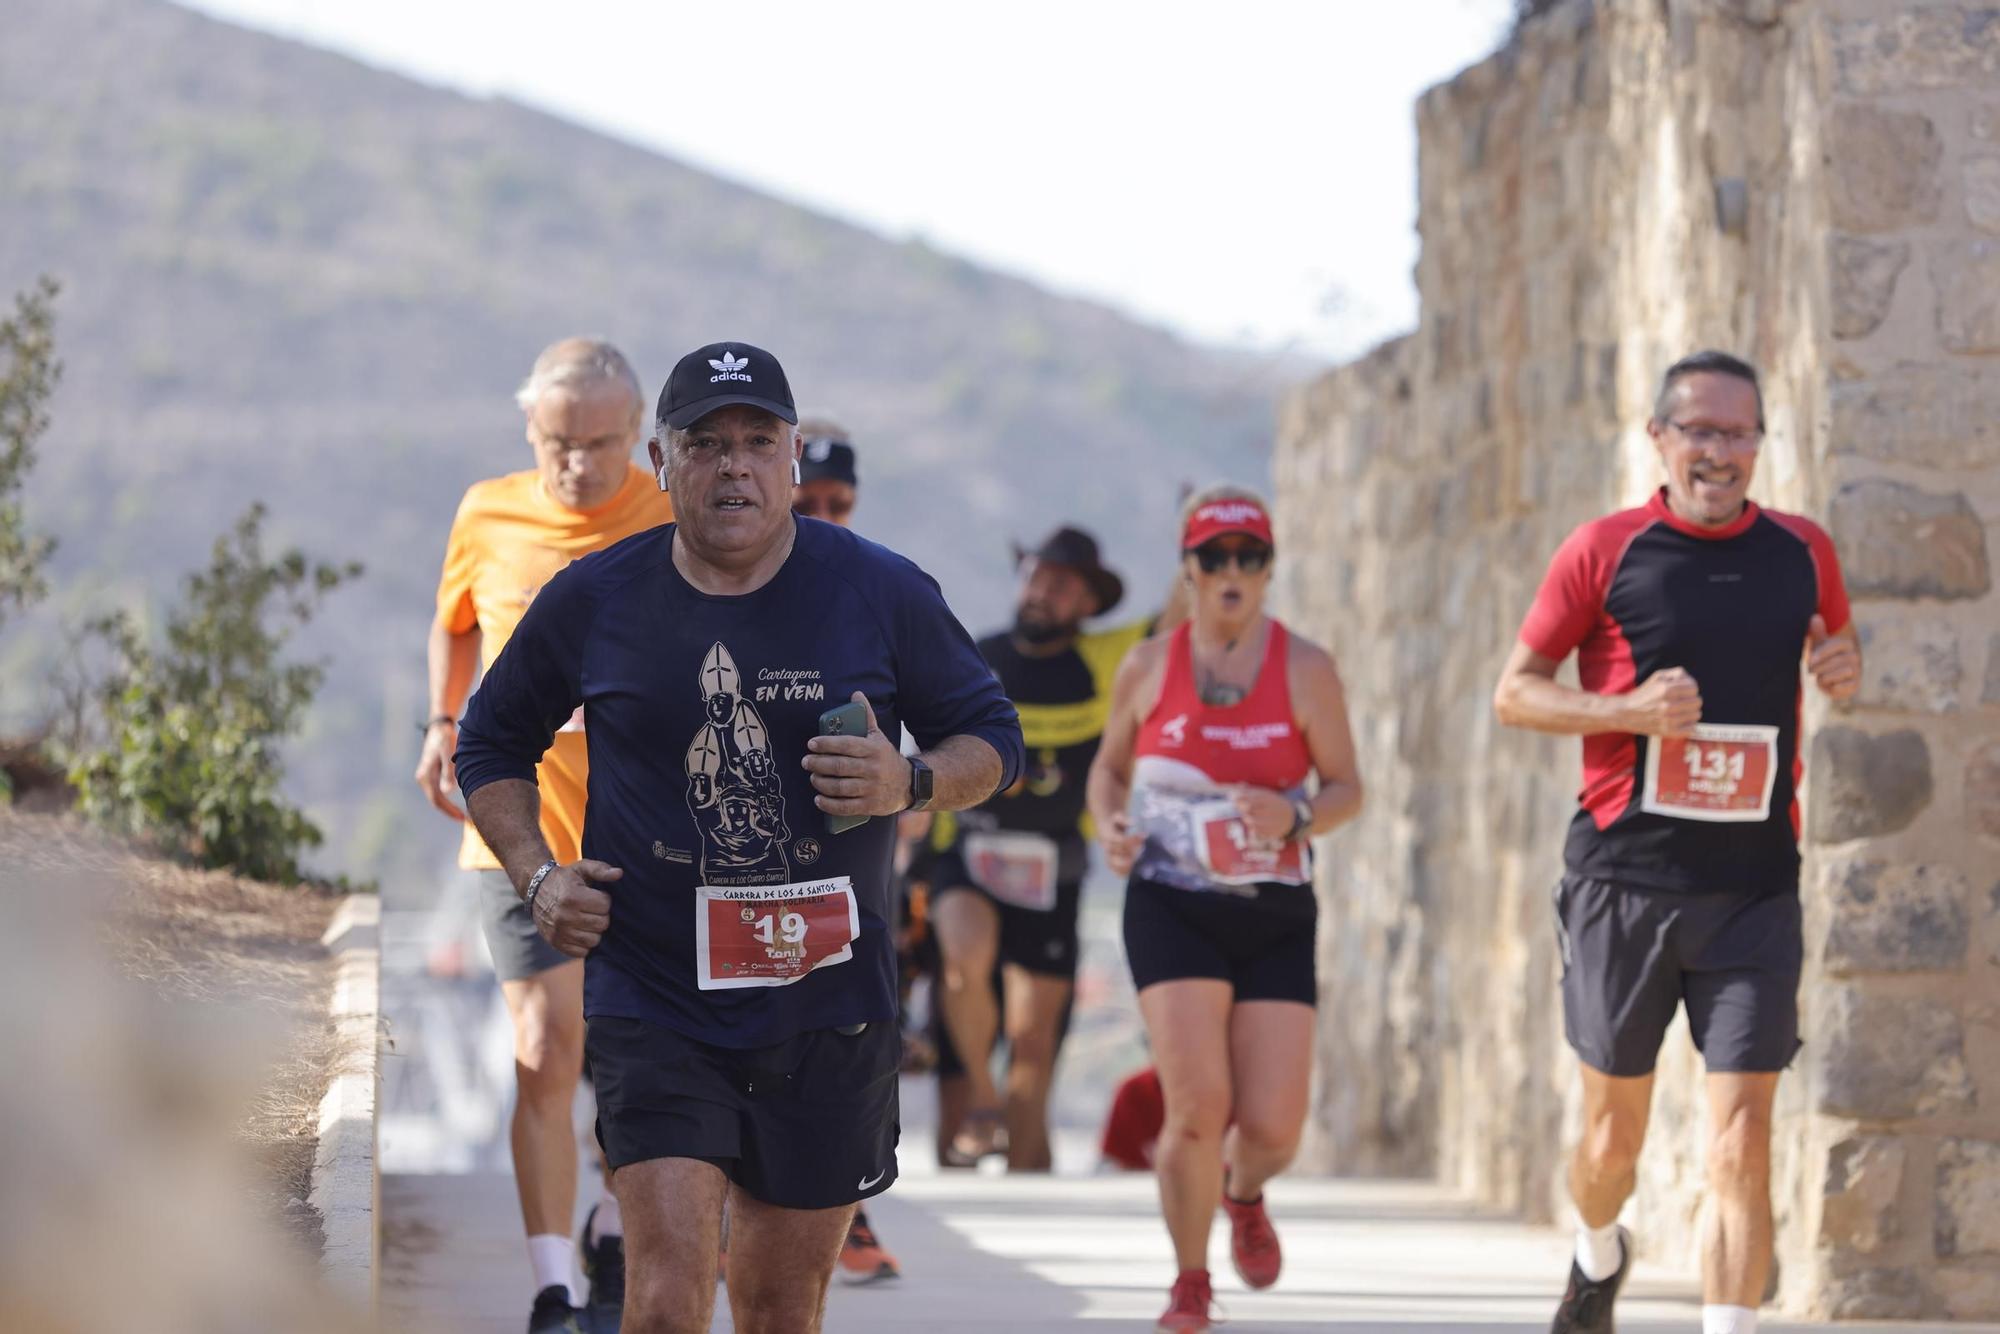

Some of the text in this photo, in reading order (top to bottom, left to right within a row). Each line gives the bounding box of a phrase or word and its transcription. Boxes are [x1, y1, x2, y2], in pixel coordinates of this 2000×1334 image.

[710, 371, 752, 383] adidas
[758, 667, 821, 686] Cartagena
[755, 682, 824, 702] EN VENA
[1684, 744, 1745, 782] 131
[723, 883, 836, 900] CARRERA DE LOS 4 SANTOS
[755, 912, 806, 944] 19
[765, 947, 796, 959] Toni
